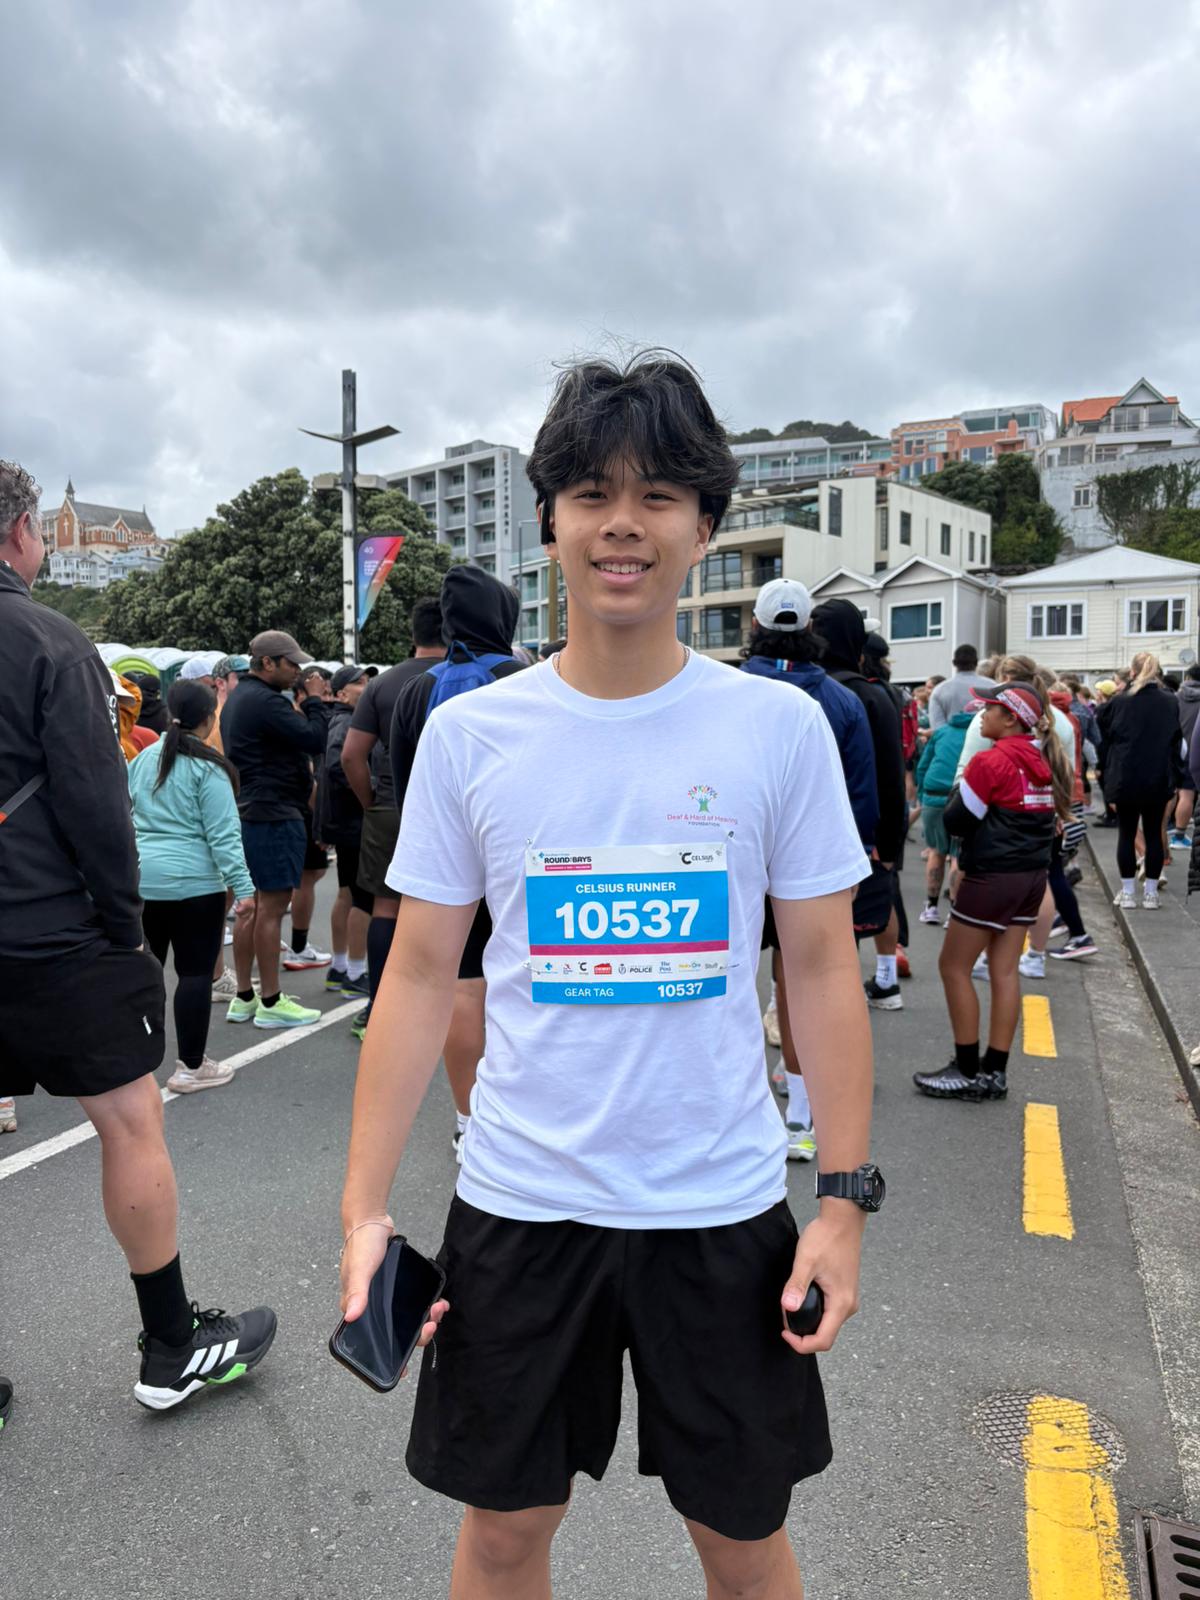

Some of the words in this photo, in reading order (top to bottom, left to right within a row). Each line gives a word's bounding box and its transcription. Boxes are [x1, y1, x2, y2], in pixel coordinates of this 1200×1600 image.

[715, 815, 738, 825] Hearing
[575, 883, 624, 894] CELSIUS
[626, 881, 677, 892] RUNNER
[555, 898, 700, 940] 10537
[629, 966, 653, 974] POLICE
[564, 988, 591, 997] GEAR
[593, 987, 614, 997] TAG
[657, 982, 704, 998] 10537
